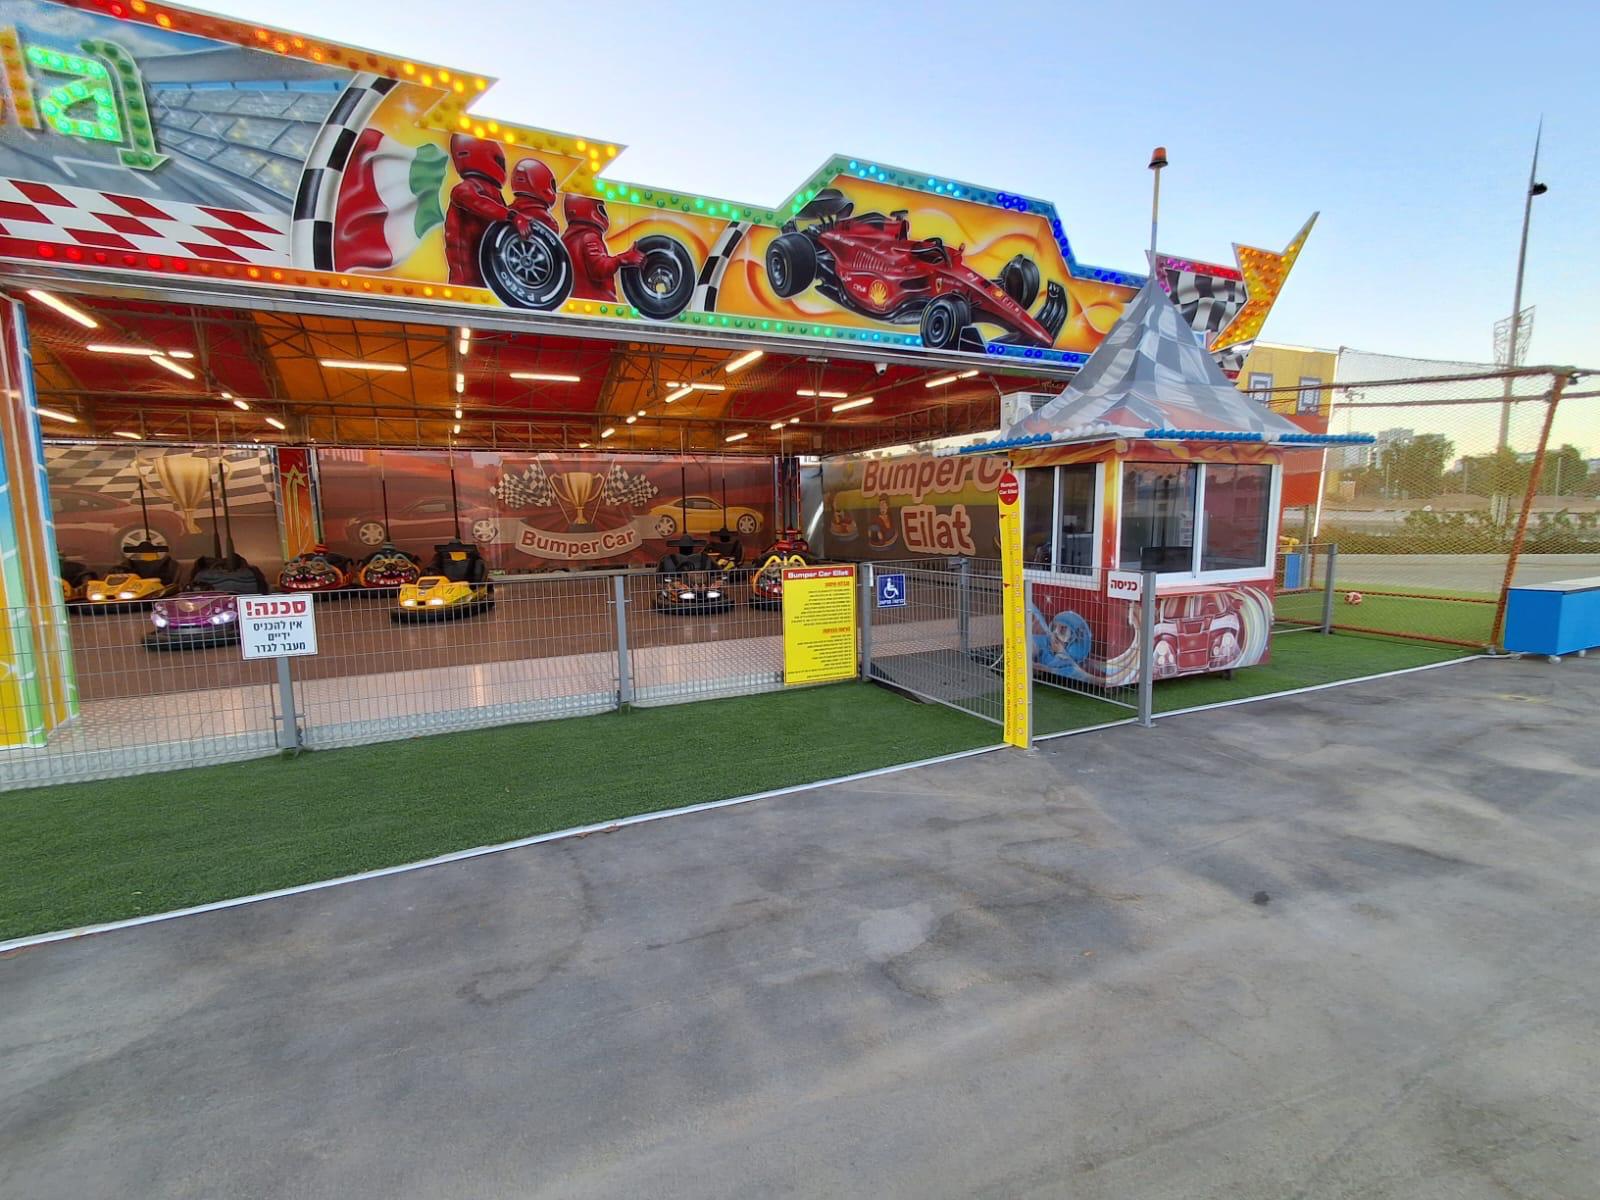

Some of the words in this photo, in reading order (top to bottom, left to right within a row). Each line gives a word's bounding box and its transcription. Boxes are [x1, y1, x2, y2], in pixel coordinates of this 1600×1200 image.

[863, 457, 972, 498] Bumper
[904, 511, 971, 549] Eilat
[521, 530, 600, 557] Bumper
[602, 531, 634, 549] Car
[1110, 580, 1138, 591] כניסה
[246, 601, 306, 616] סכנה!
[253, 621, 286, 632] להכניס
[290, 621, 302, 631] אין
[268, 632, 291, 641] ידיים
[254, 643, 277, 653] לגדר
[280, 642, 306, 651] מעבר
